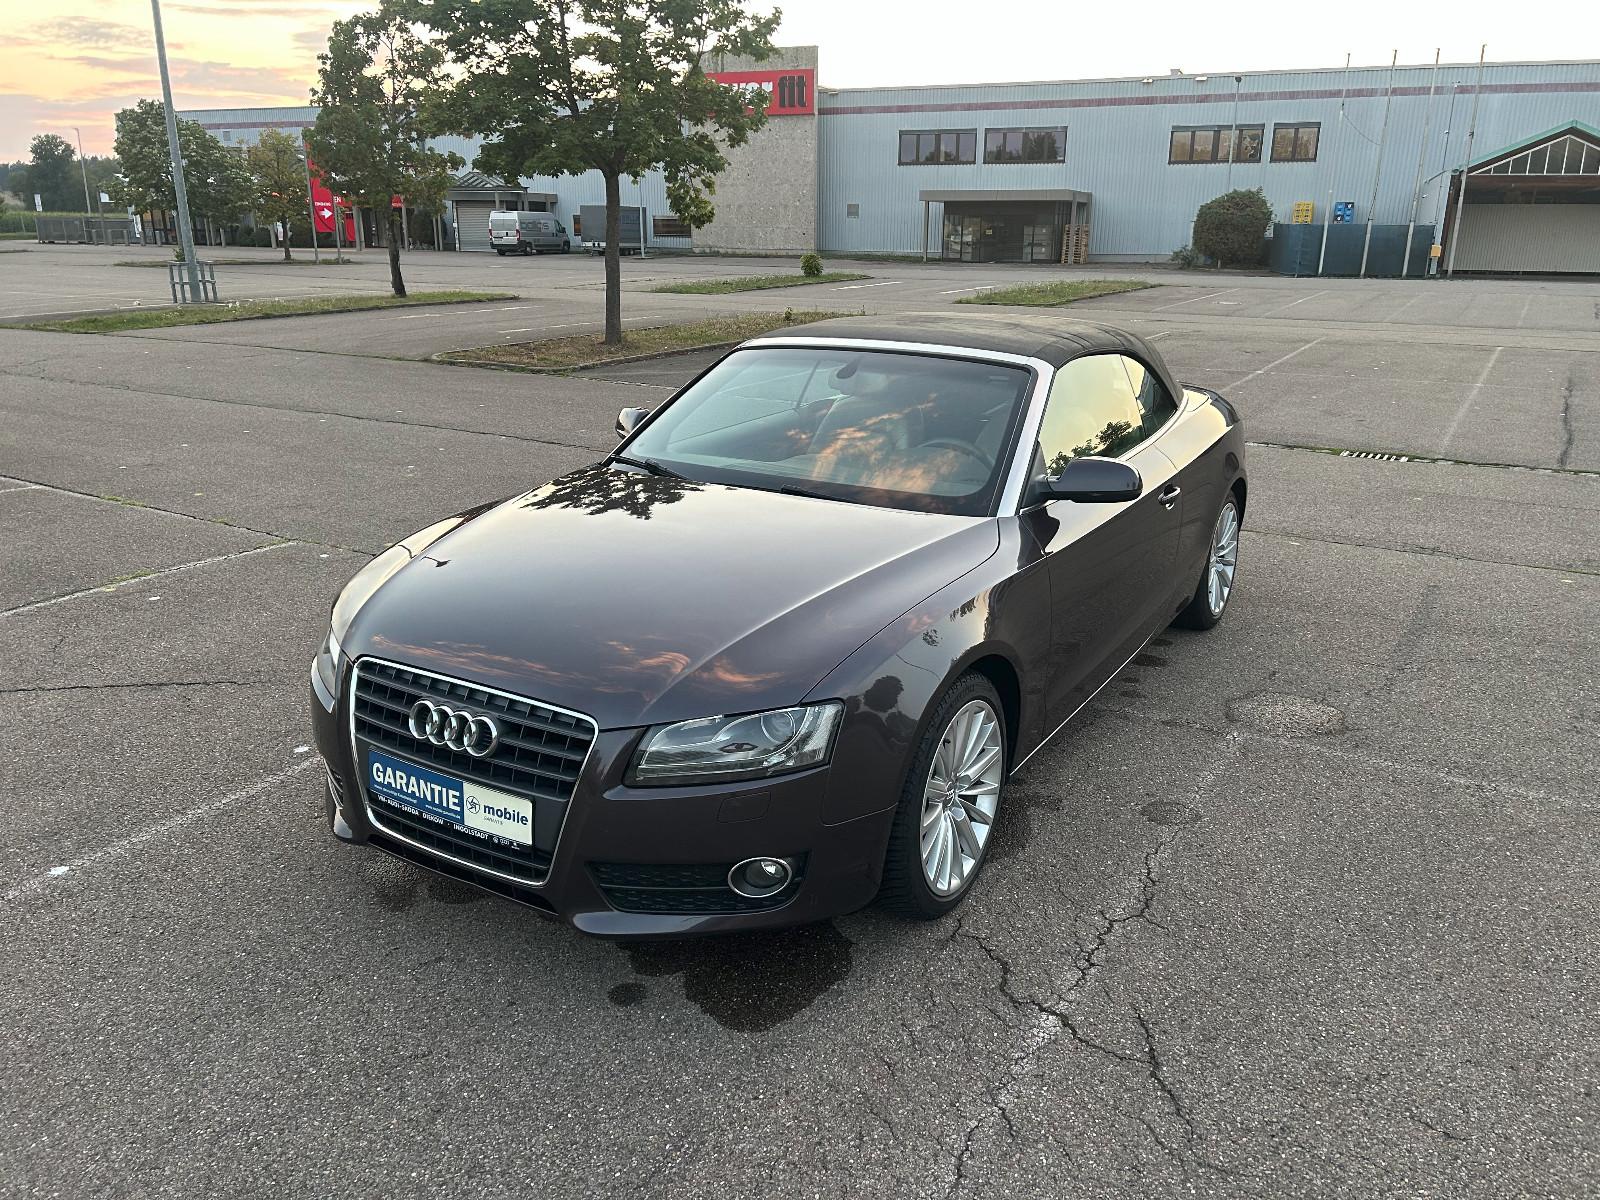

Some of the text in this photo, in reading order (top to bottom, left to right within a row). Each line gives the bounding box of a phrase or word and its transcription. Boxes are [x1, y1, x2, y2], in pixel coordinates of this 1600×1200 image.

[778, 75, 807, 107] fit
[372, 762, 461, 812] GARANTIE
[483, 804, 528, 826] mobile
[453, 824, 489, 840] INGOLSTADT
